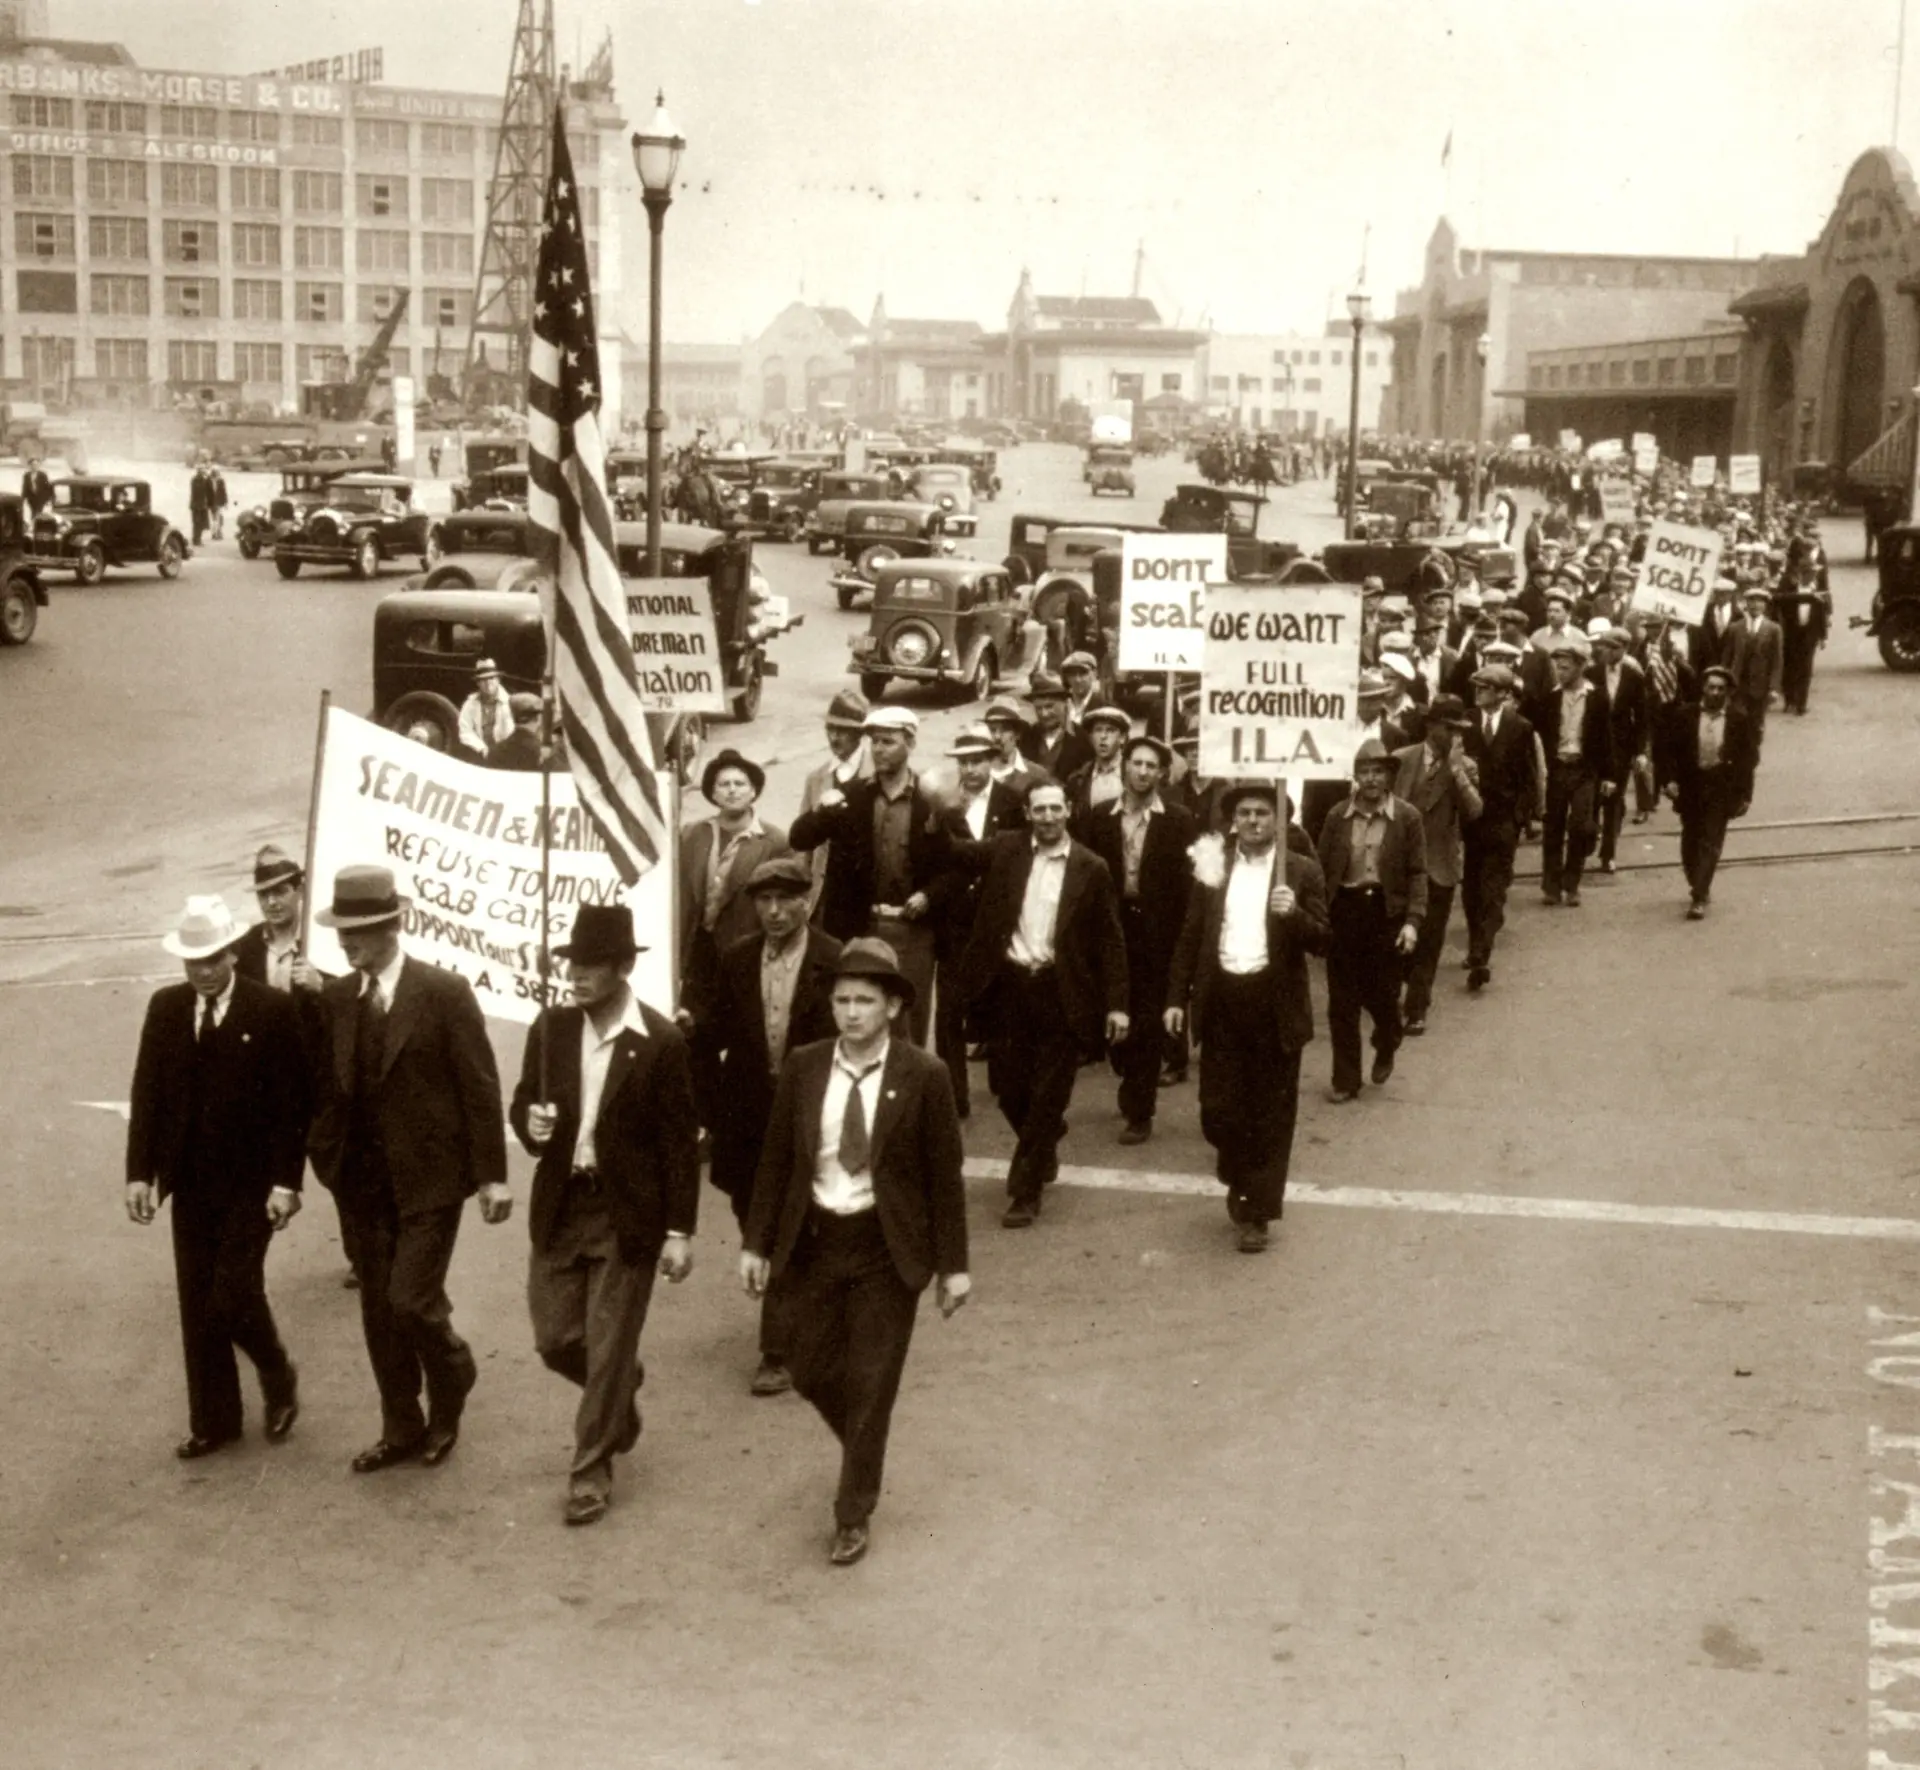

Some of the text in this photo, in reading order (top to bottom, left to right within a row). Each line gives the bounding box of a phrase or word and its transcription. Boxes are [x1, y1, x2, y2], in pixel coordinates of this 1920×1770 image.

[140, 72, 243, 104] MORSE
[258, 82, 281, 108] &
[637, 663, 712, 693] iation
[1247, 660, 1308, 685] FULL
[1231, 727, 1334, 765] I.L.A.
[502, 816, 530, 845] &
[386, 825, 498, 884] REFUSE
[400, 908, 485, 957] UPPORT
